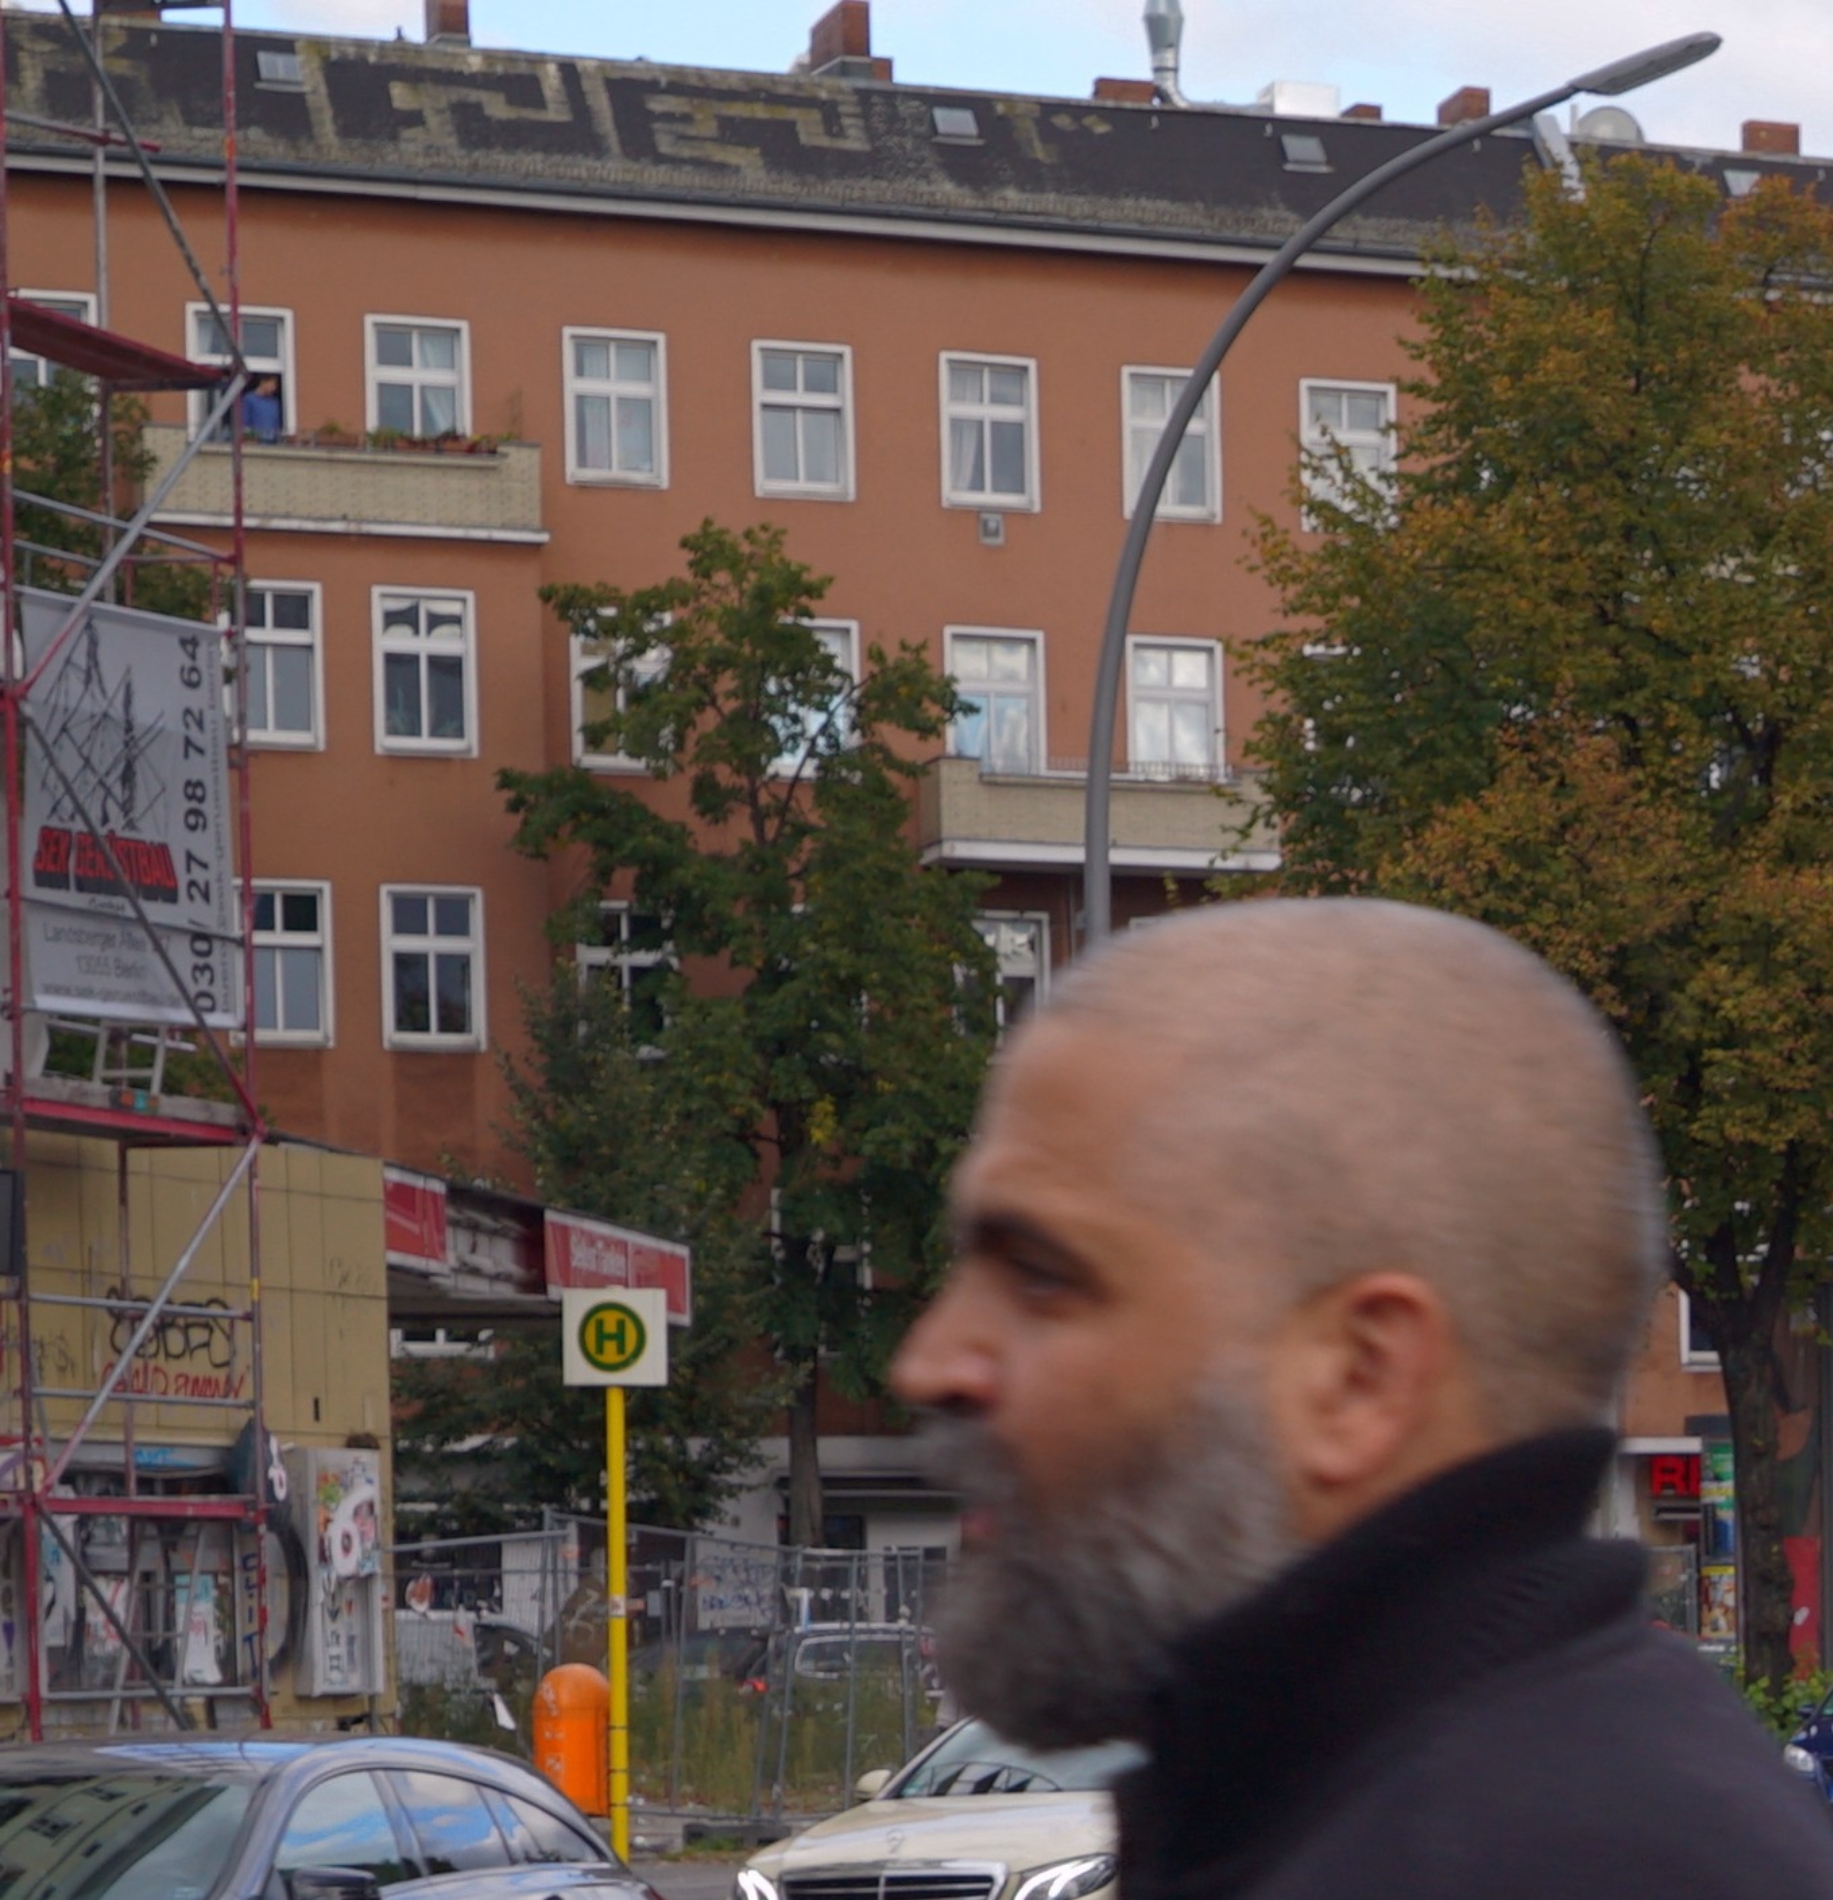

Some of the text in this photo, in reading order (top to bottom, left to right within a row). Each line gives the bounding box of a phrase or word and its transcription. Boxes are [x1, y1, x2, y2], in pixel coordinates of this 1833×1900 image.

[179, 634, 202, 689] 64
[182, 706, 206, 761] 72
[184, 777, 208, 833] 98
[187, 850, 211, 905] 27
[595, 1318, 626, 1355] H
